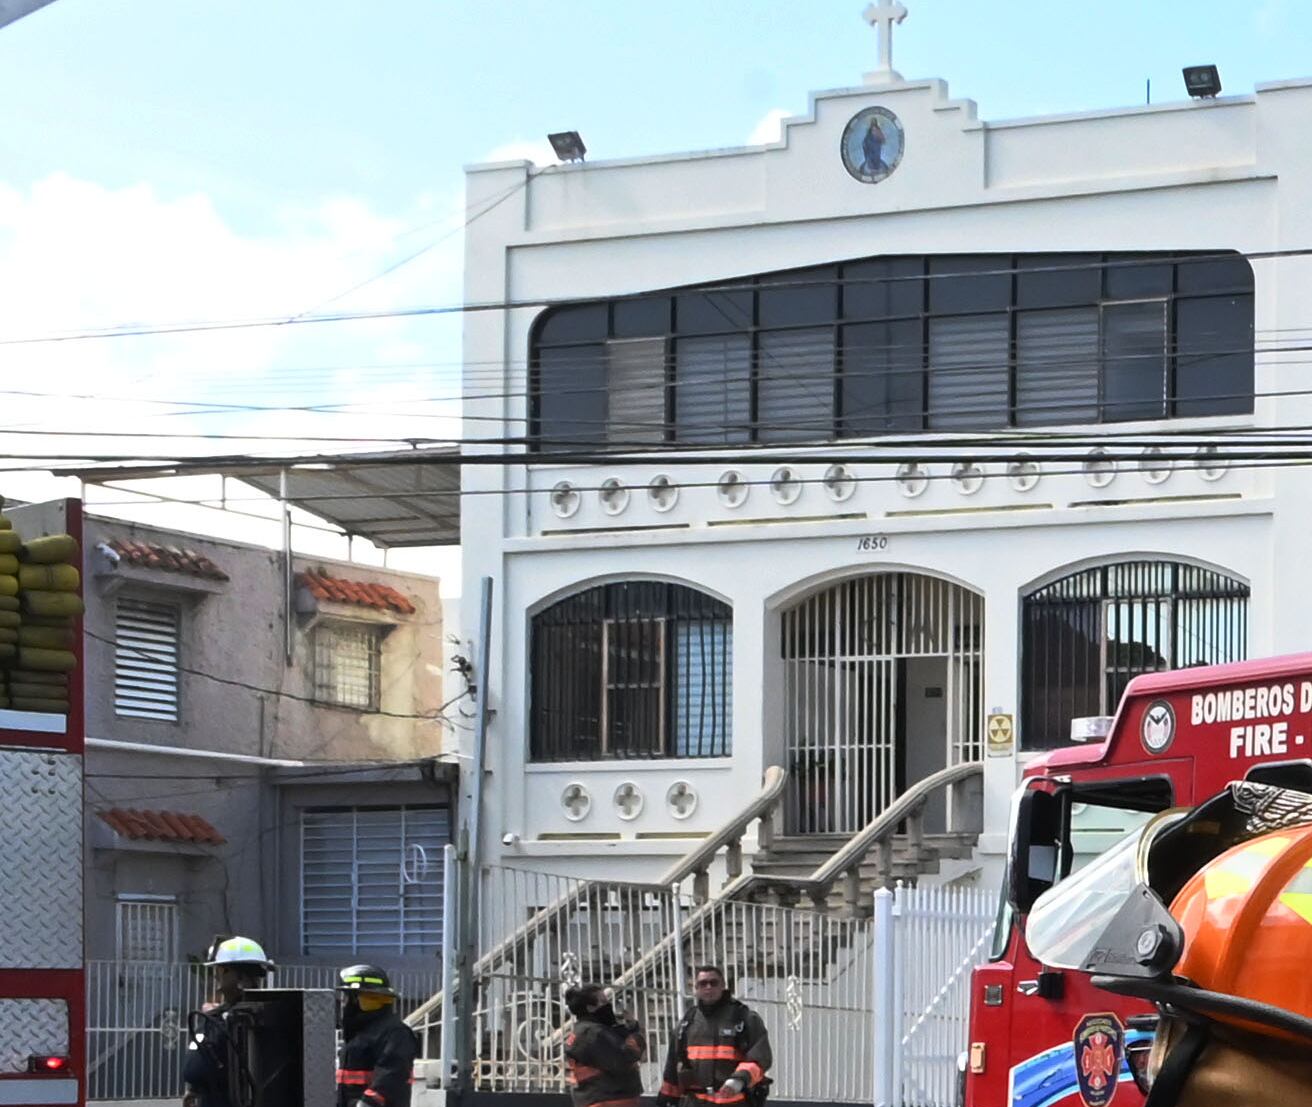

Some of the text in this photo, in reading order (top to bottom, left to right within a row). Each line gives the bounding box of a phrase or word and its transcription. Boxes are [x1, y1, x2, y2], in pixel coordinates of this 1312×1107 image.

[857, 536, 888, 551] 1650
[1190, 683, 1295, 726] BOMBEROS
[1229, 721, 1288, 759] FIRE
